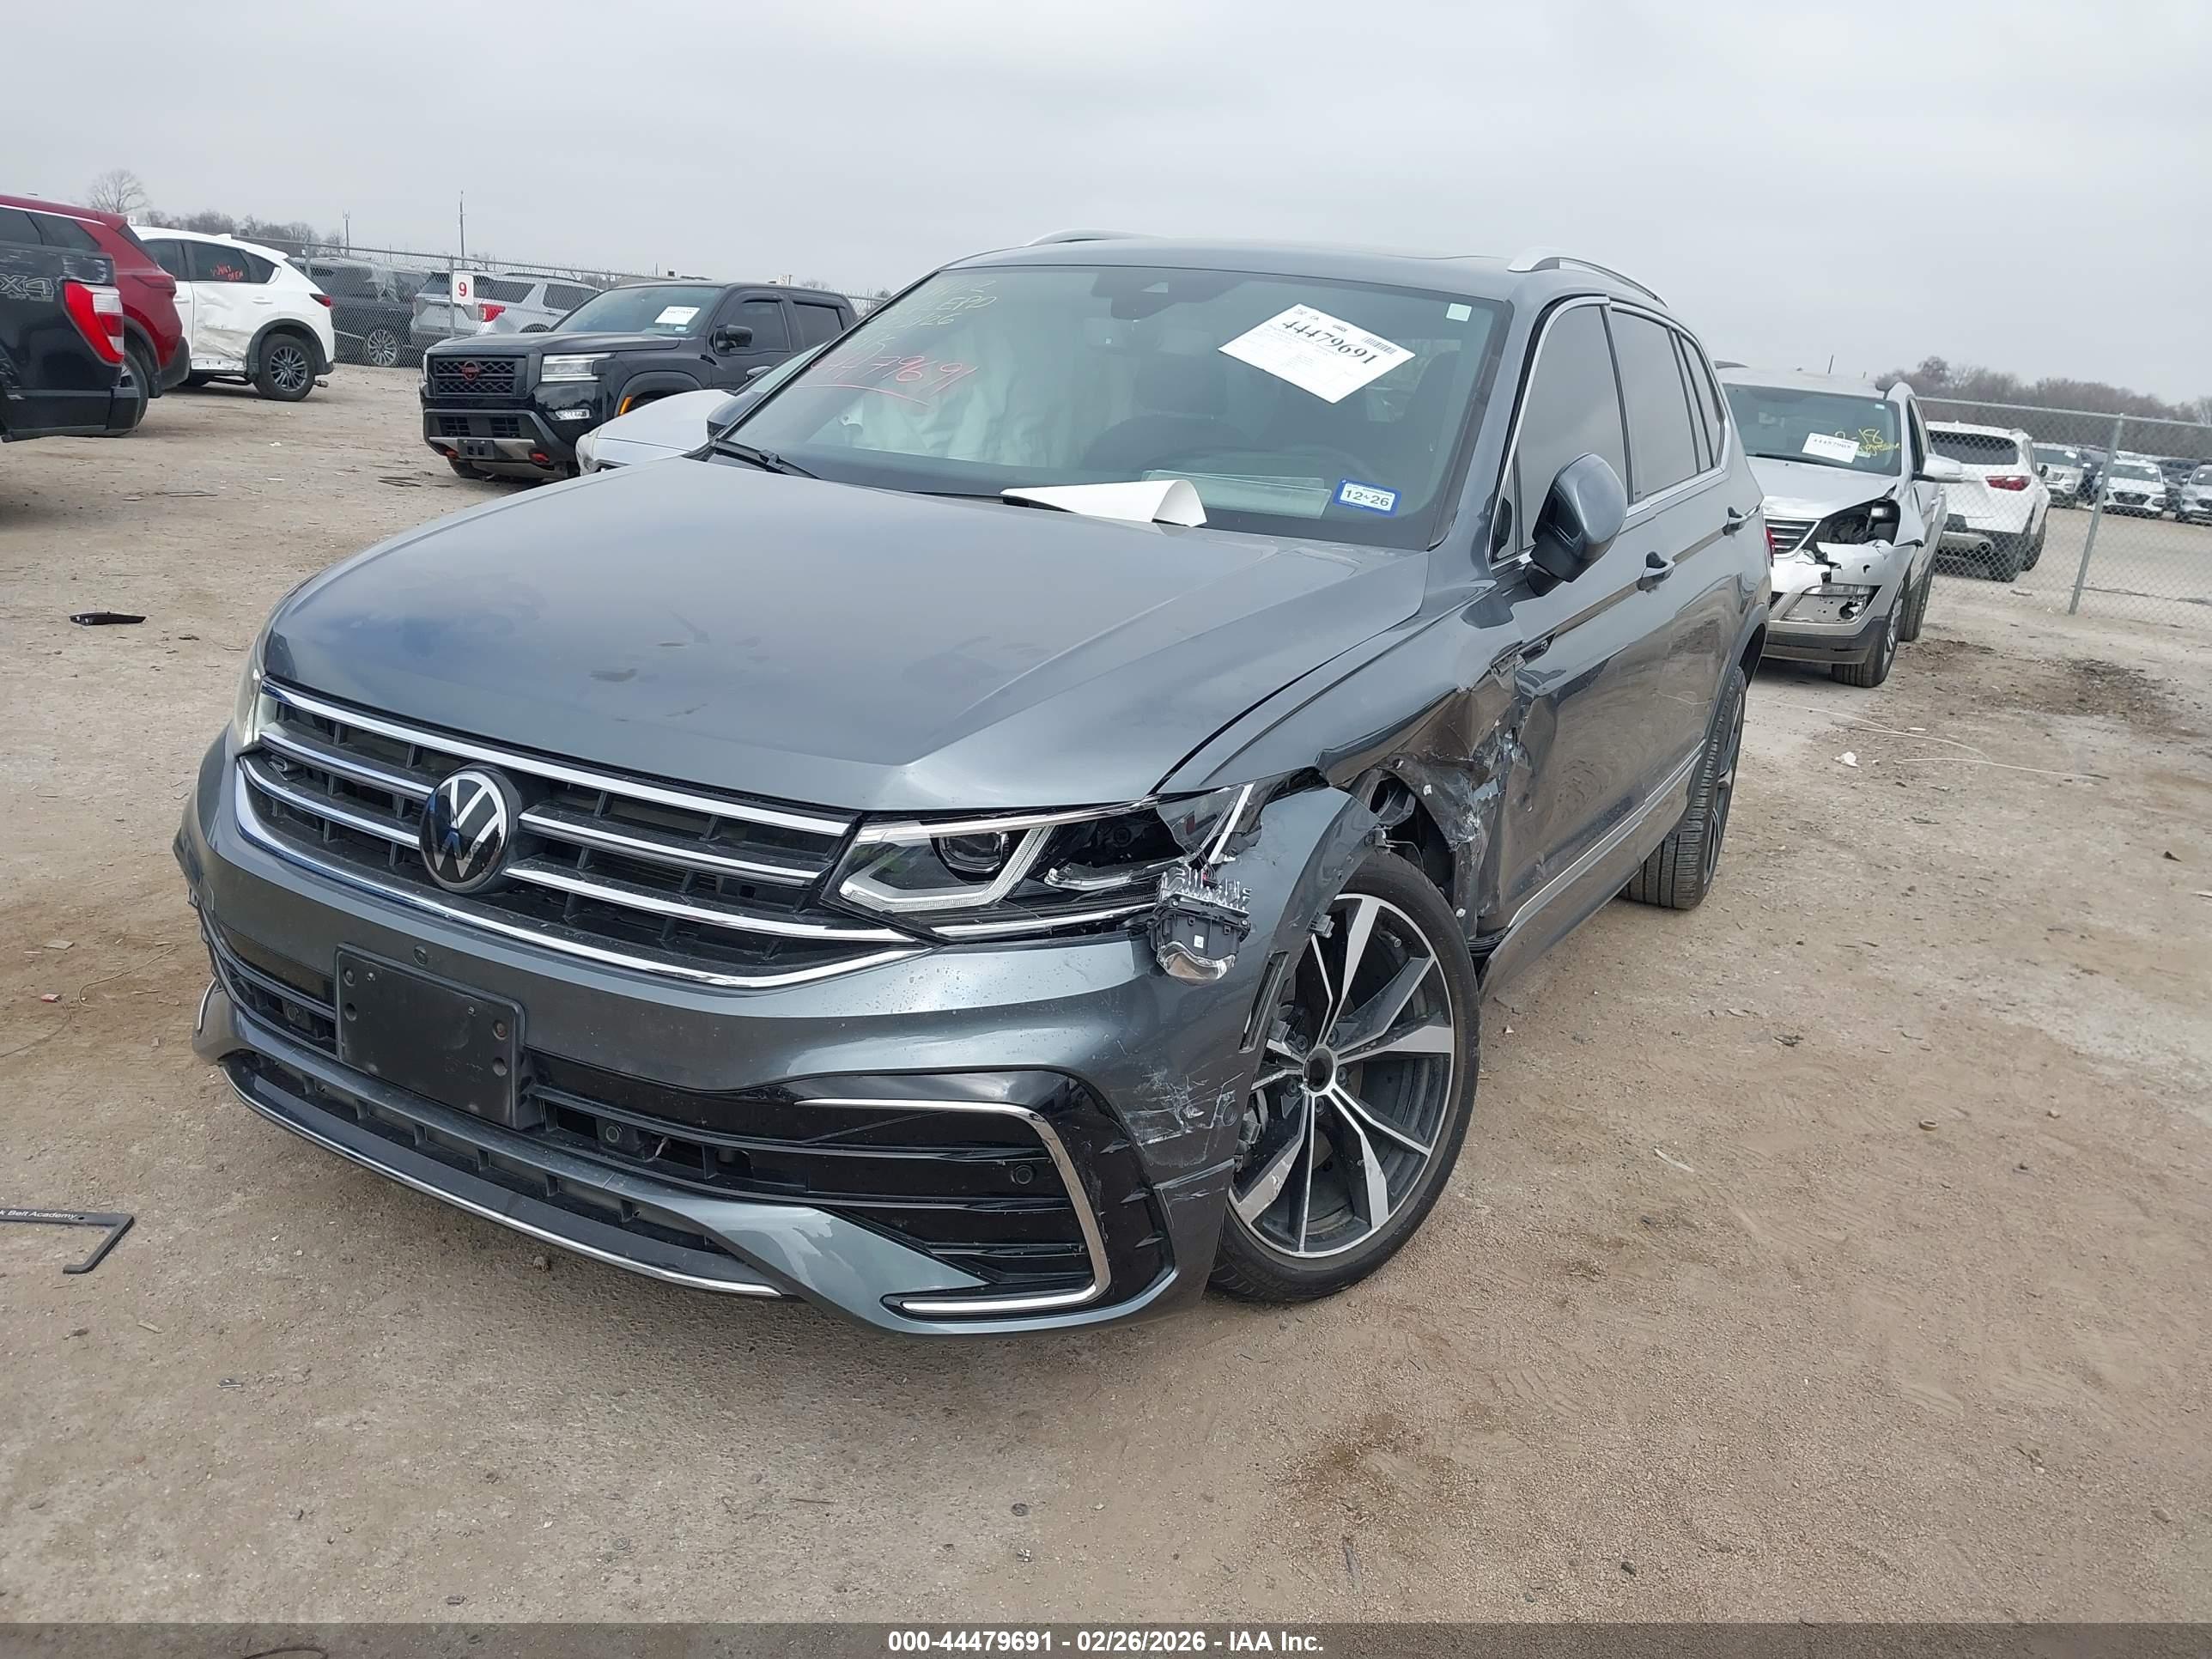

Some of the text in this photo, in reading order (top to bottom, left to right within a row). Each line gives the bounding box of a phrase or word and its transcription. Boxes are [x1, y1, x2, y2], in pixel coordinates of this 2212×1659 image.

[458, 281, 468, 298] 9
[1282, 320, 1378, 365] 44479691
[1370, 495, 1389, 507] 26
[28, 1211, 78, 1220] Academy
